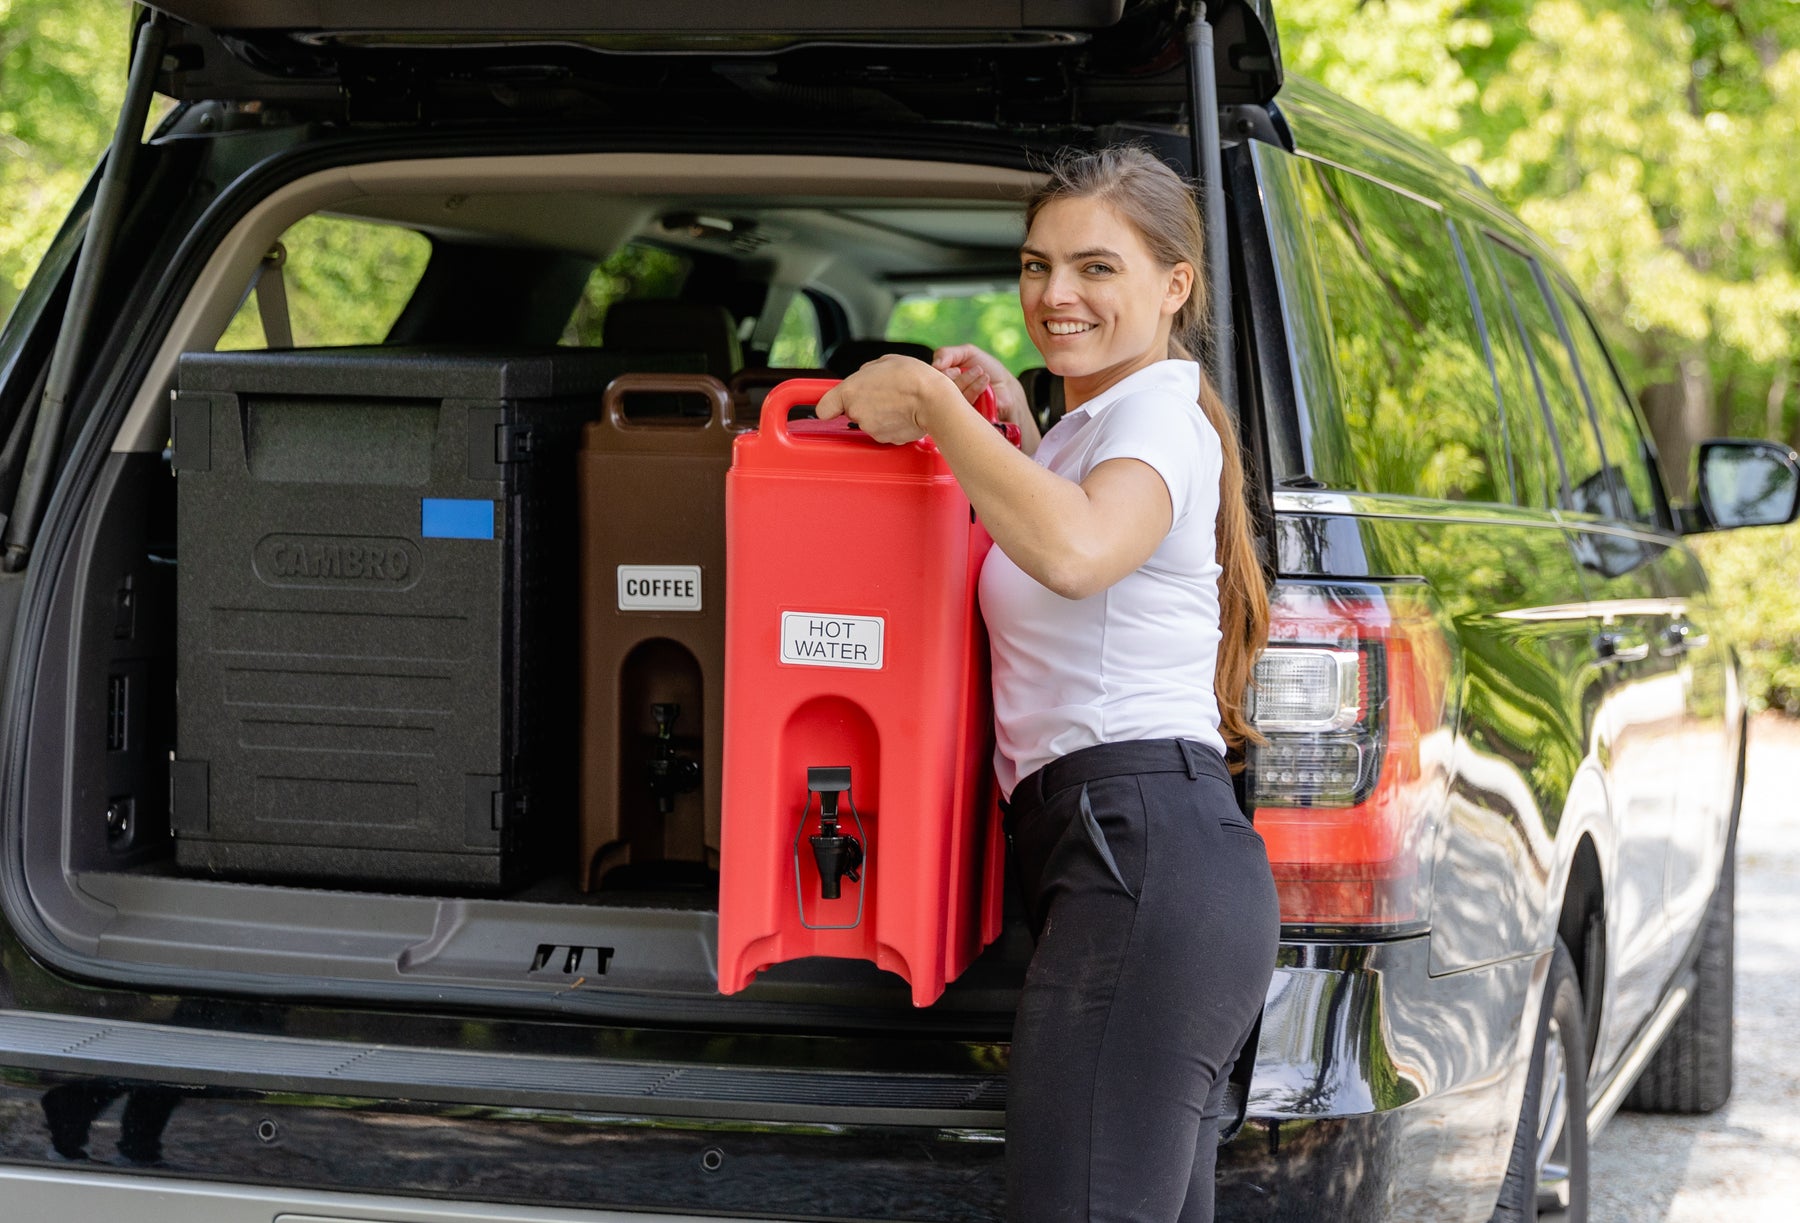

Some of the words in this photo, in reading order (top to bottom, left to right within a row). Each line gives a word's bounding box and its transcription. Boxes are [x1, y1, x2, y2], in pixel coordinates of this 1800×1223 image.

[272, 543, 410, 581] CAMBRO
[626, 579, 695, 598] COFFEE
[809, 620, 855, 639] HOT
[795, 640, 868, 661] WATER
